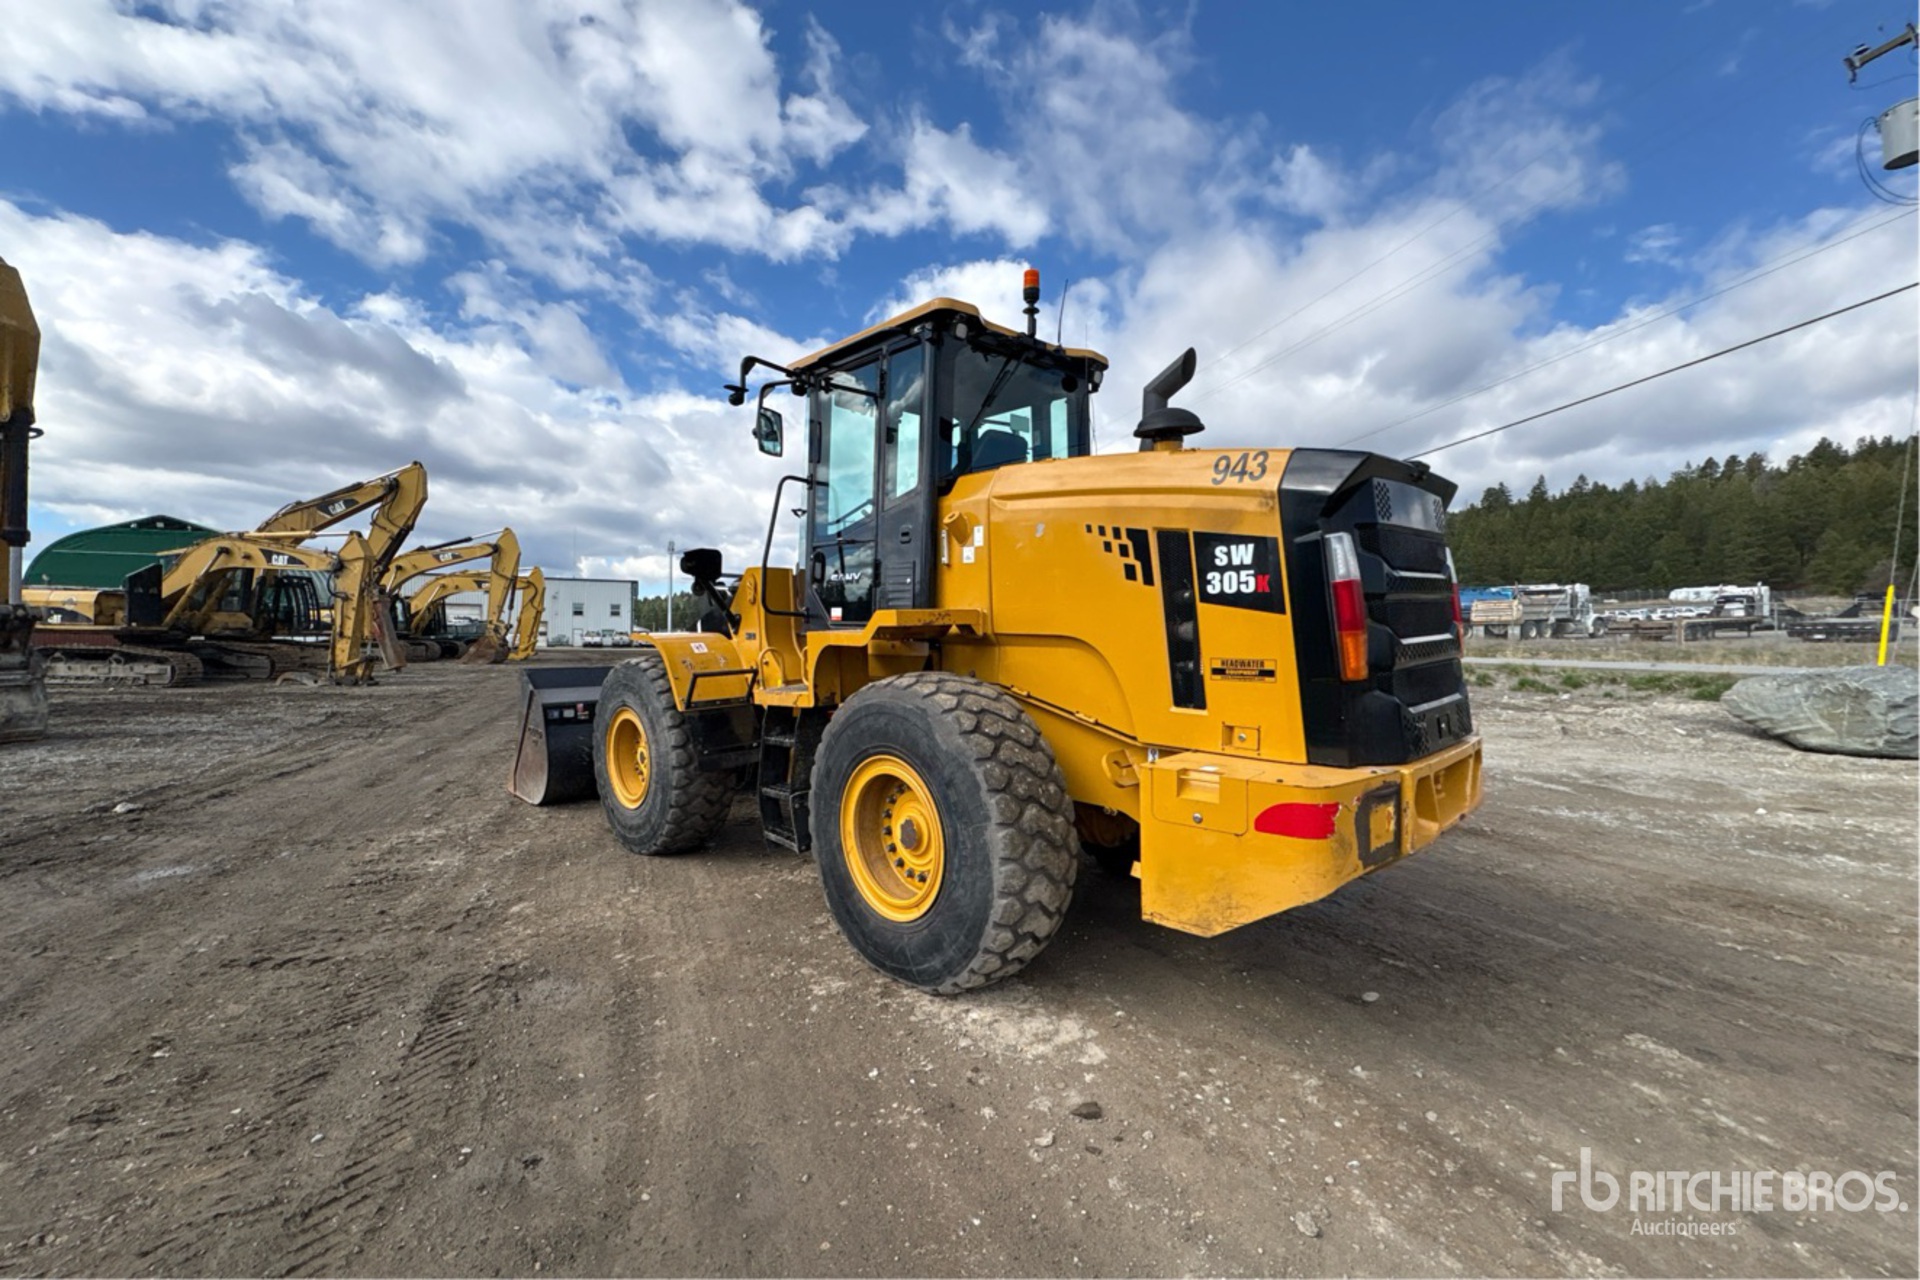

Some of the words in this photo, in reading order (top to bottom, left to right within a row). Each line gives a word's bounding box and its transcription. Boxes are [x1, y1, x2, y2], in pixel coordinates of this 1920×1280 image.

[1211, 451, 1269, 485] 943
[271, 554, 289, 566] CAT
[1214, 543, 1255, 567] SW
[1206, 570, 1271, 595] 305K
